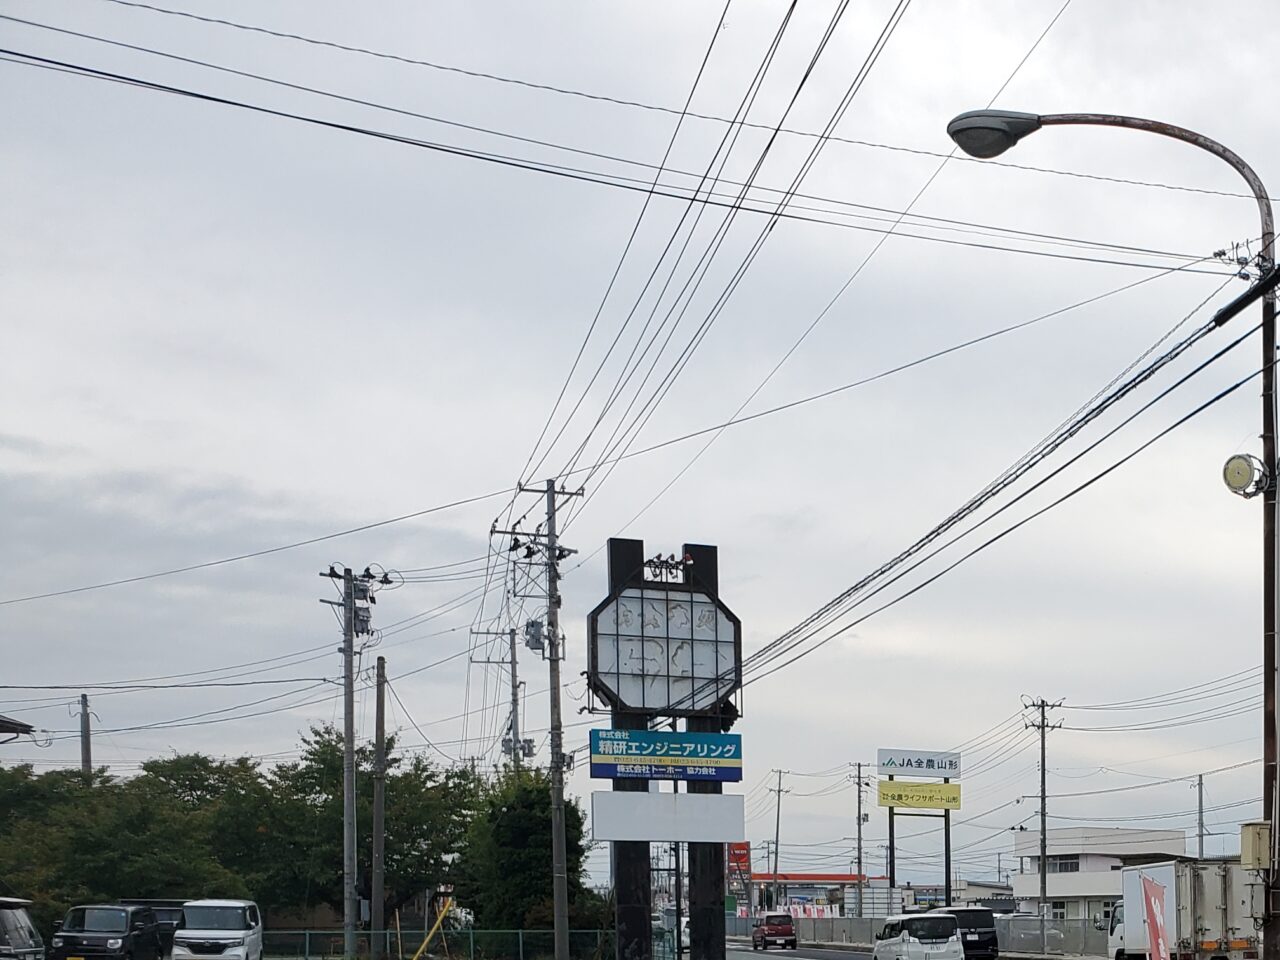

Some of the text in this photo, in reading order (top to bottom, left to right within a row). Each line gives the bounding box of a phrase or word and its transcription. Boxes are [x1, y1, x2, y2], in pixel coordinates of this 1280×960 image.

[598, 740, 737, 758] 精研エンジニアリング
